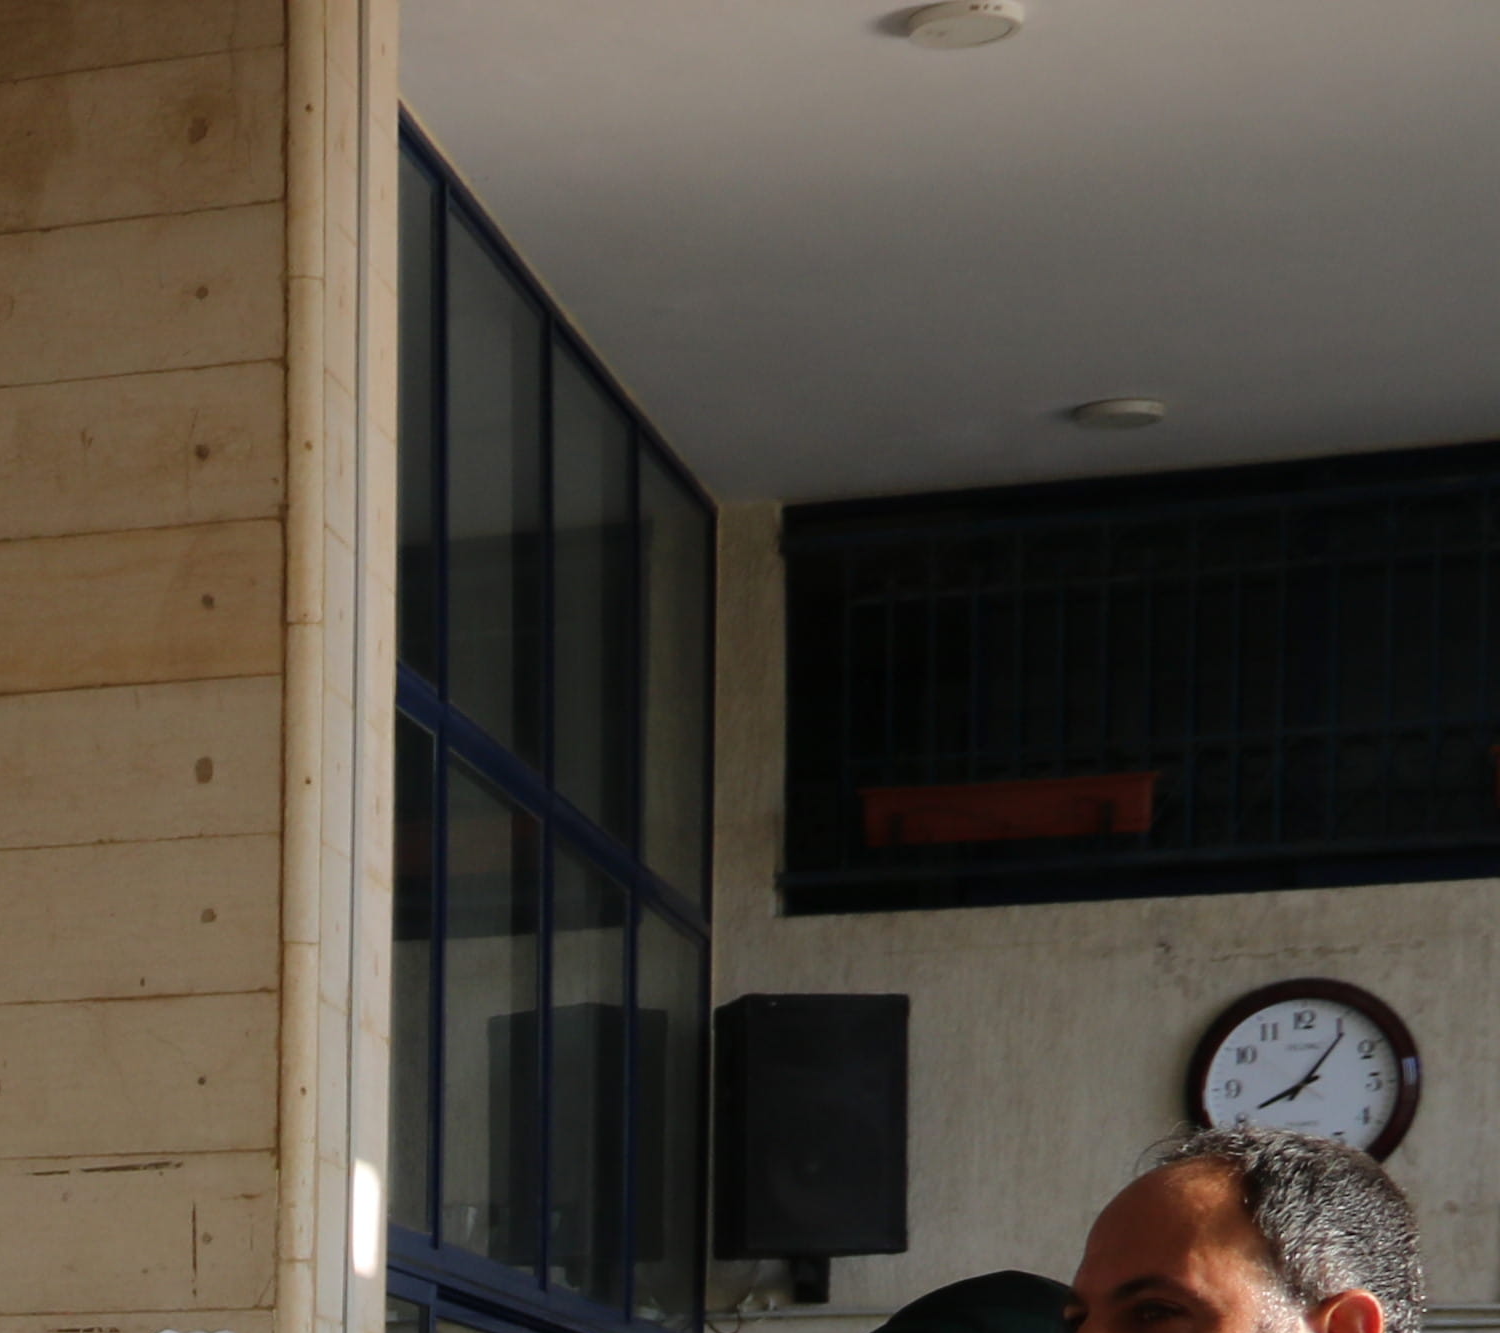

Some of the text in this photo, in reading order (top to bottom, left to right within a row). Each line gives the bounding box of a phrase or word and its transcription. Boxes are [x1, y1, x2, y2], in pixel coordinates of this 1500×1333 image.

[1292, 1009, 1316, 1030] 12
[1260, 1022, 1279, 1042] 11
[1235, 1045, 1258, 1065] 10
[1224, 1079, 1243, 1099] 9
